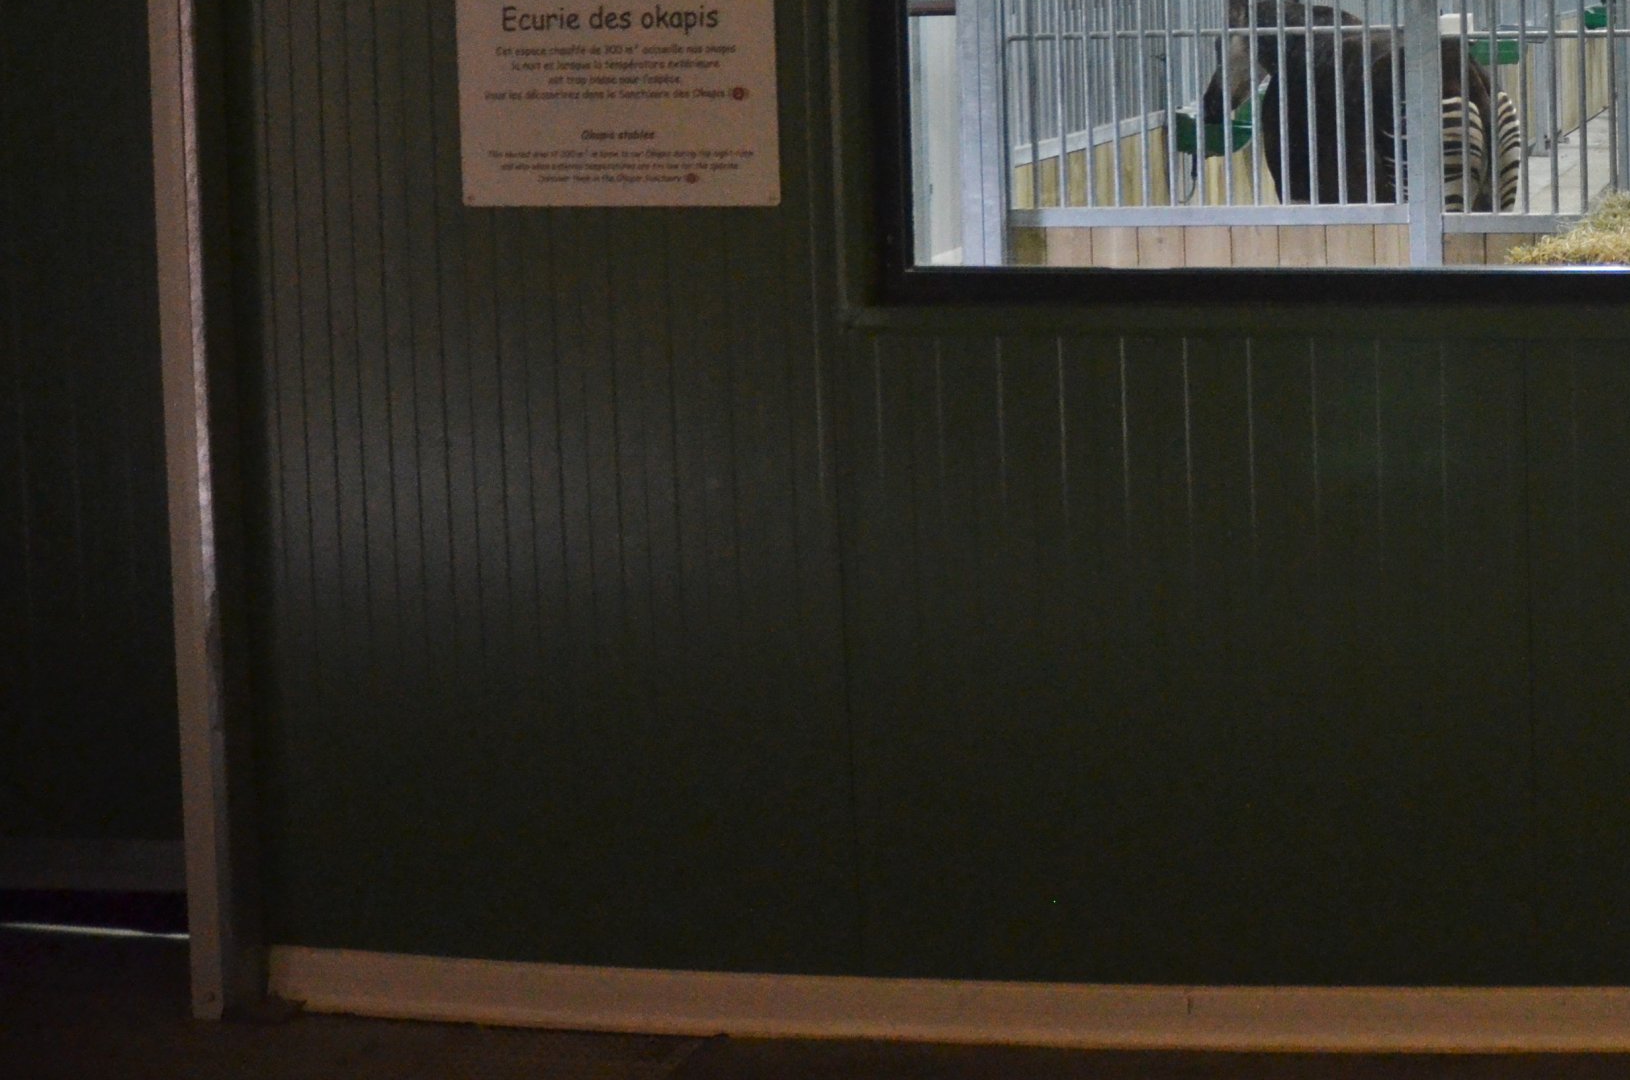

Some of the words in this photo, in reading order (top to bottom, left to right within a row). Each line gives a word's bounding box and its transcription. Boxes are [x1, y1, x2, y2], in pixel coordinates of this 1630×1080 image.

[502, 6, 580, 31] Ecurie
[589, 5, 631, 30] des
[640, 3, 719, 35] okapis
